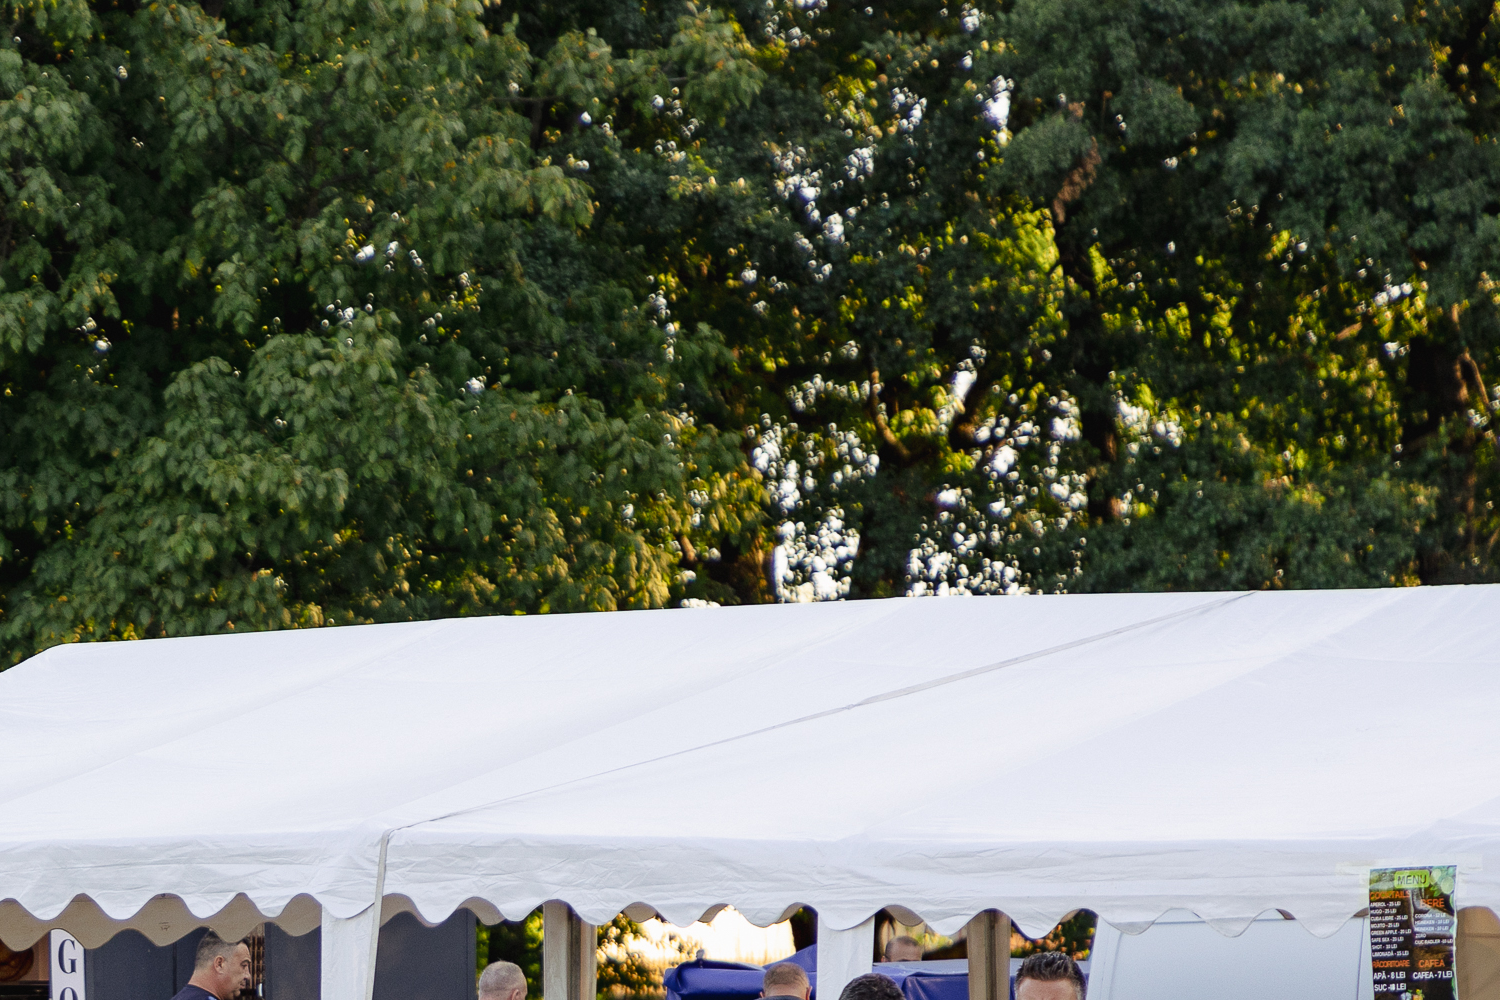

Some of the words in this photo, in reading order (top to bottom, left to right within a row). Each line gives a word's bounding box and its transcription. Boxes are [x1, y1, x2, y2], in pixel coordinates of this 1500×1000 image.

[1397, 874, 1427, 885] MENU
[1370, 890, 1410, 899] COCKTAILS
[1420, 898, 1446, 908] BERE
[1419, 959, 1445, 968] CAFEA
[1373, 971, 1387, 979] APĂ
[1413, 971, 1434, 979] CAFEA
[1396, 983, 1406, 991] LEI
